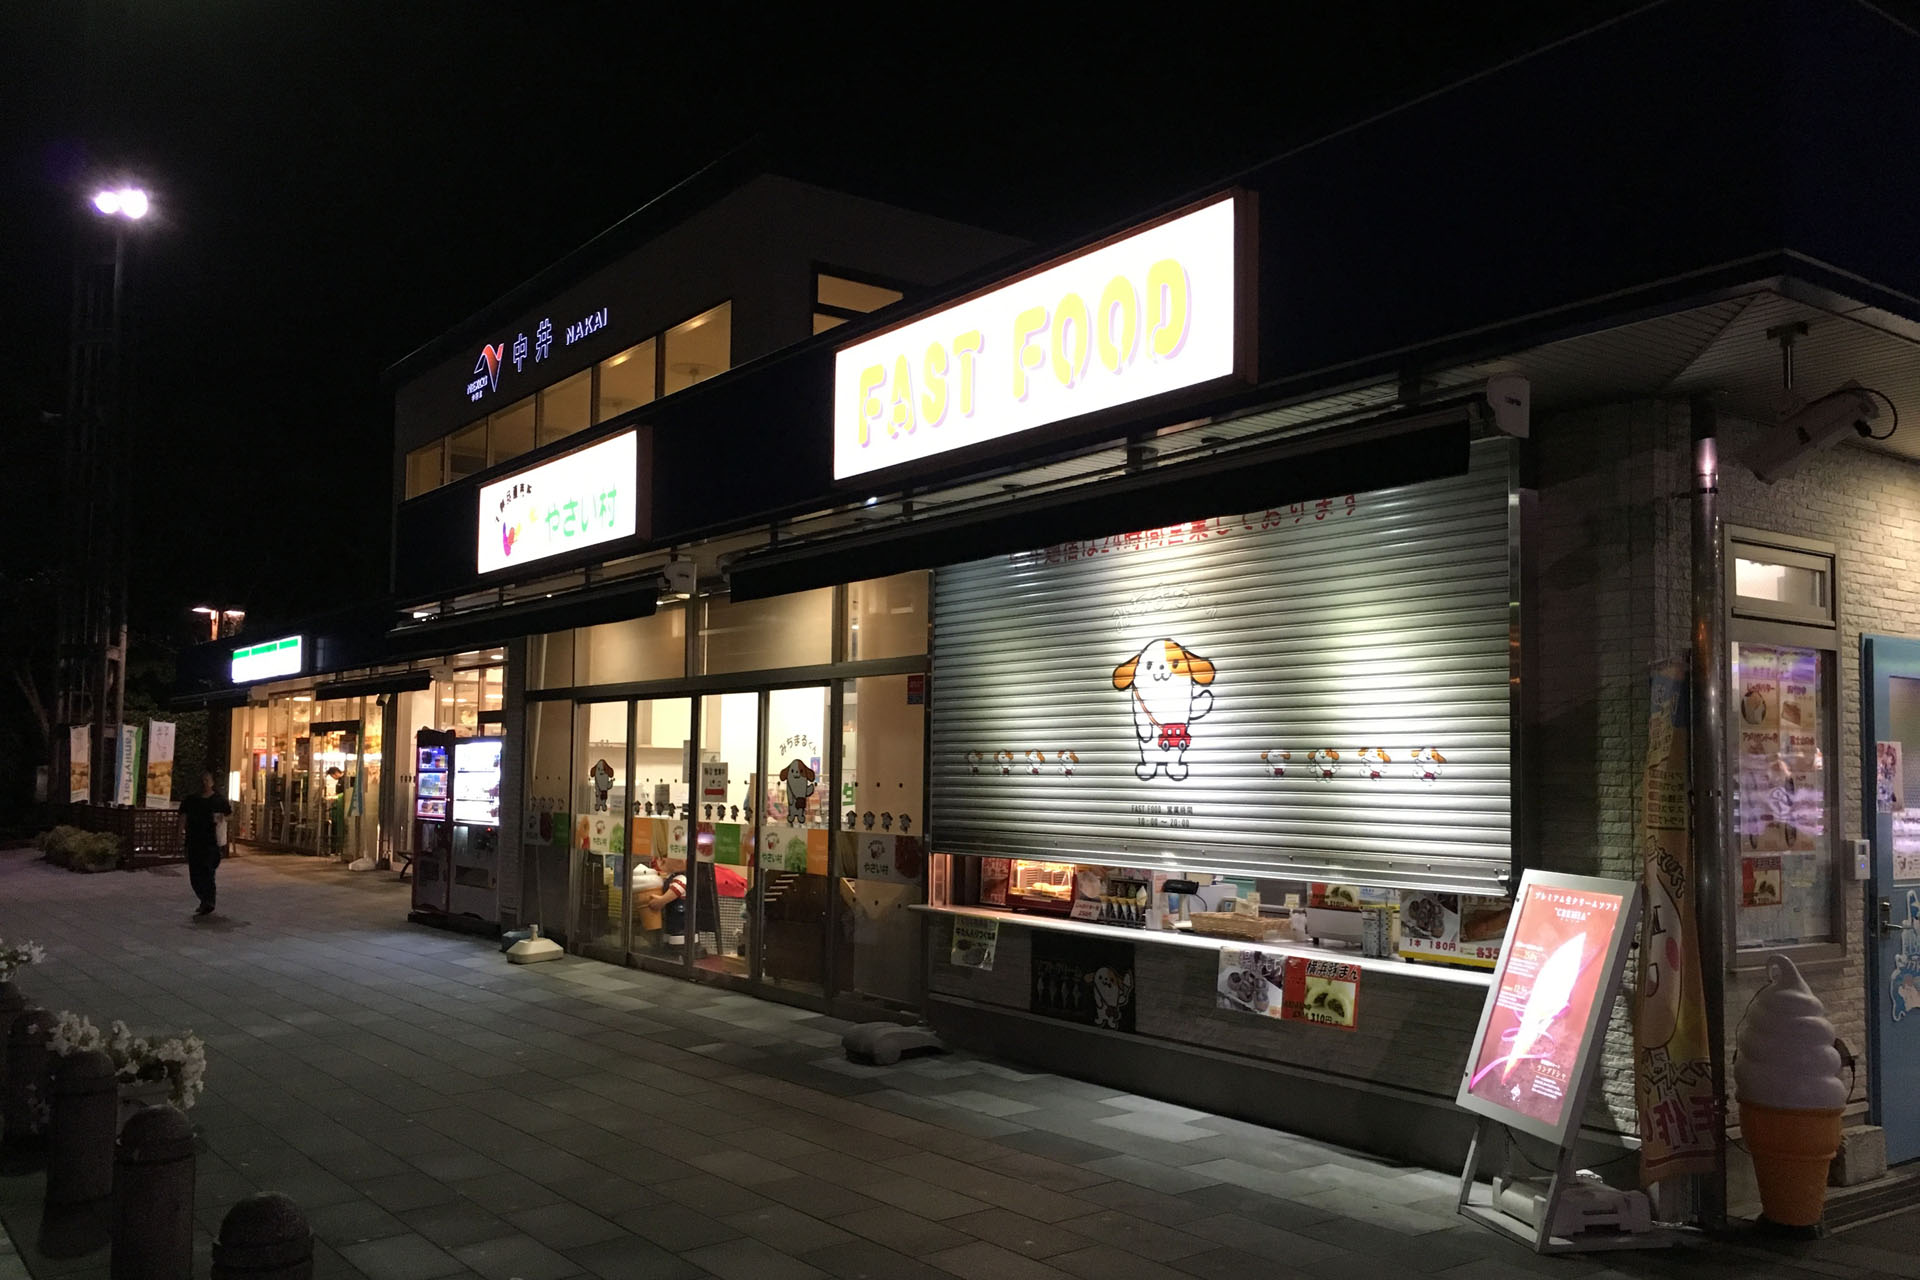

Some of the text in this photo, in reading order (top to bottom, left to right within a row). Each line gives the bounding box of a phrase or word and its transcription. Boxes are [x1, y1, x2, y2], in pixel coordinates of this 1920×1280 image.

[512, 307, 608, 373] 中井 NAKAI
[858, 258, 1192, 448] FAST FOOD
[466, 375, 489, 396] NEXCO
[779, 734, 817, 757] みちまるくん
[123, 729, 134, 801] FamilyMart
[1535, 892, 1619, 912] プレミアム生クリームソフト
[1430, 940, 1457, 952] 180円
[1310, 1013, 1333, 1025] 310円
